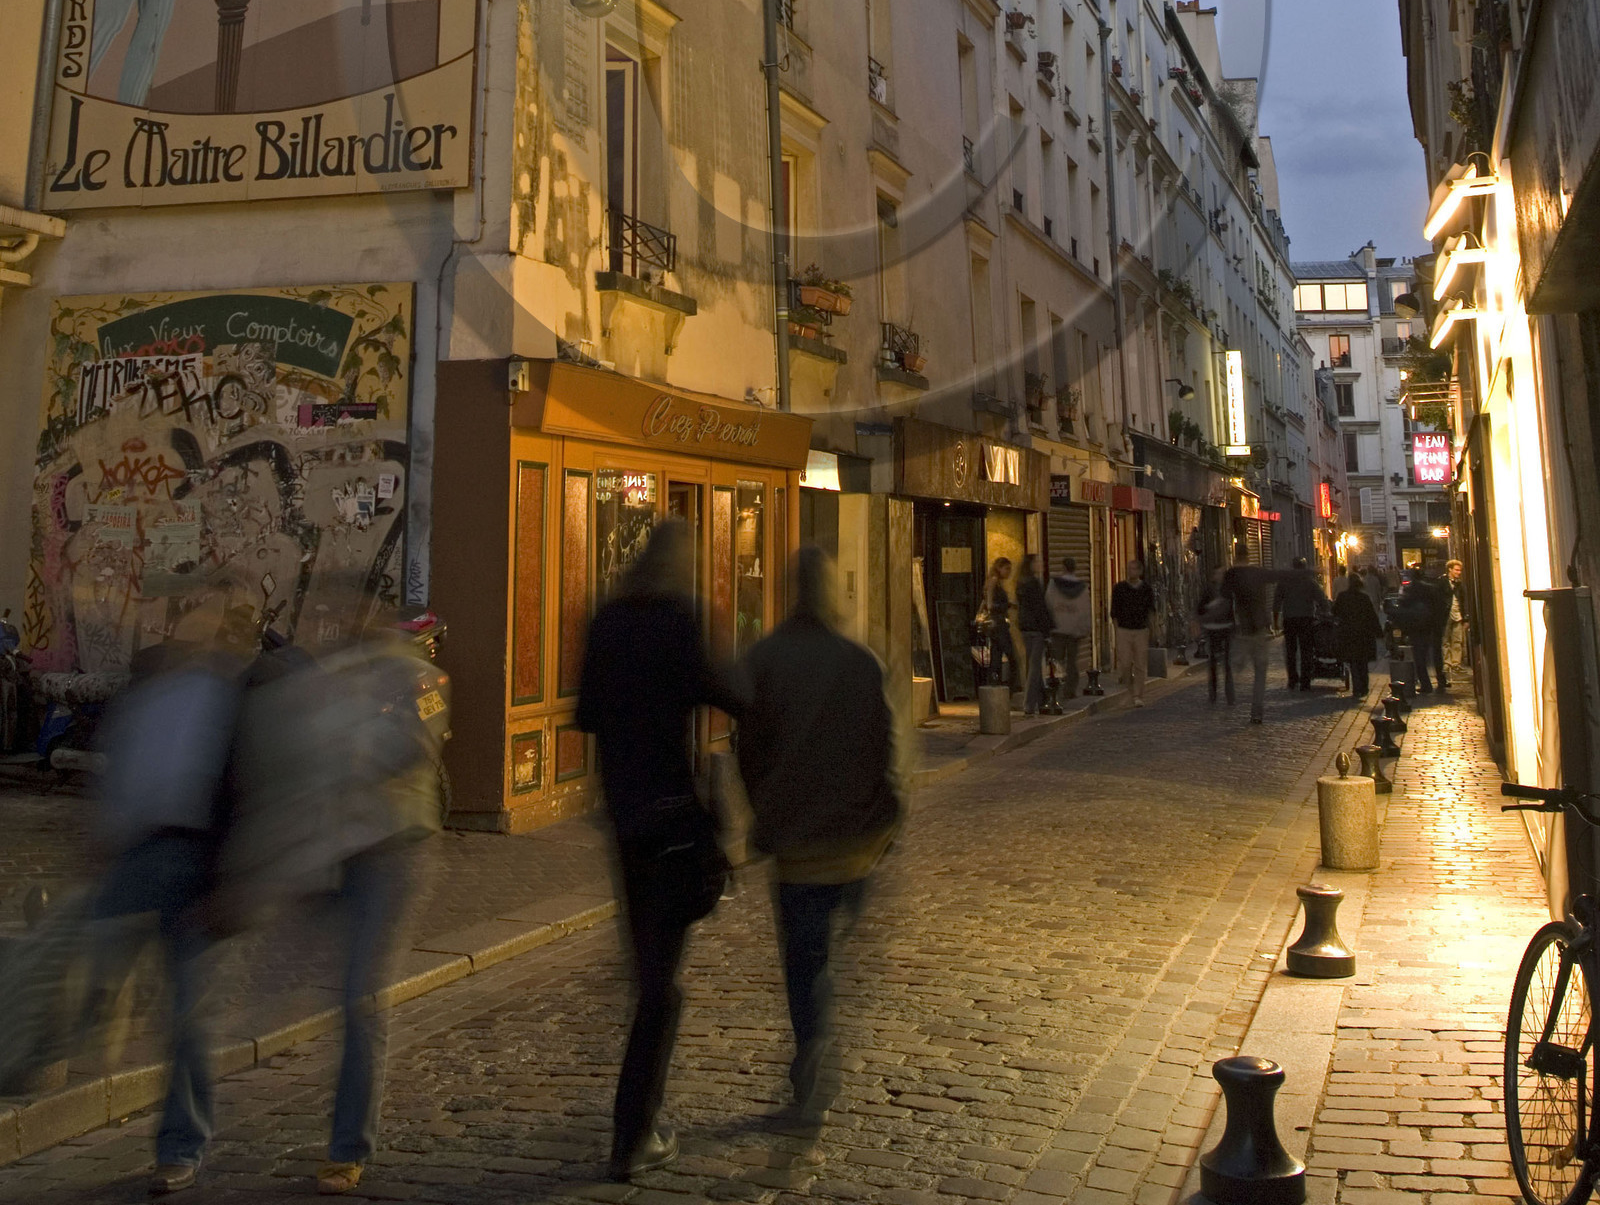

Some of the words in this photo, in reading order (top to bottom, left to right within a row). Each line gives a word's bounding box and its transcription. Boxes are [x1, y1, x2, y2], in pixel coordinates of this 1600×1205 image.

[50, 97, 111, 192] Le
[254, 93, 457, 182] Billardier
[149, 317, 206, 343] Vieux
[226, 311, 339, 359] Comptoirs
[1415, 436, 1445, 448] L'EAU
[1420, 468, 1444, 481] BAR
